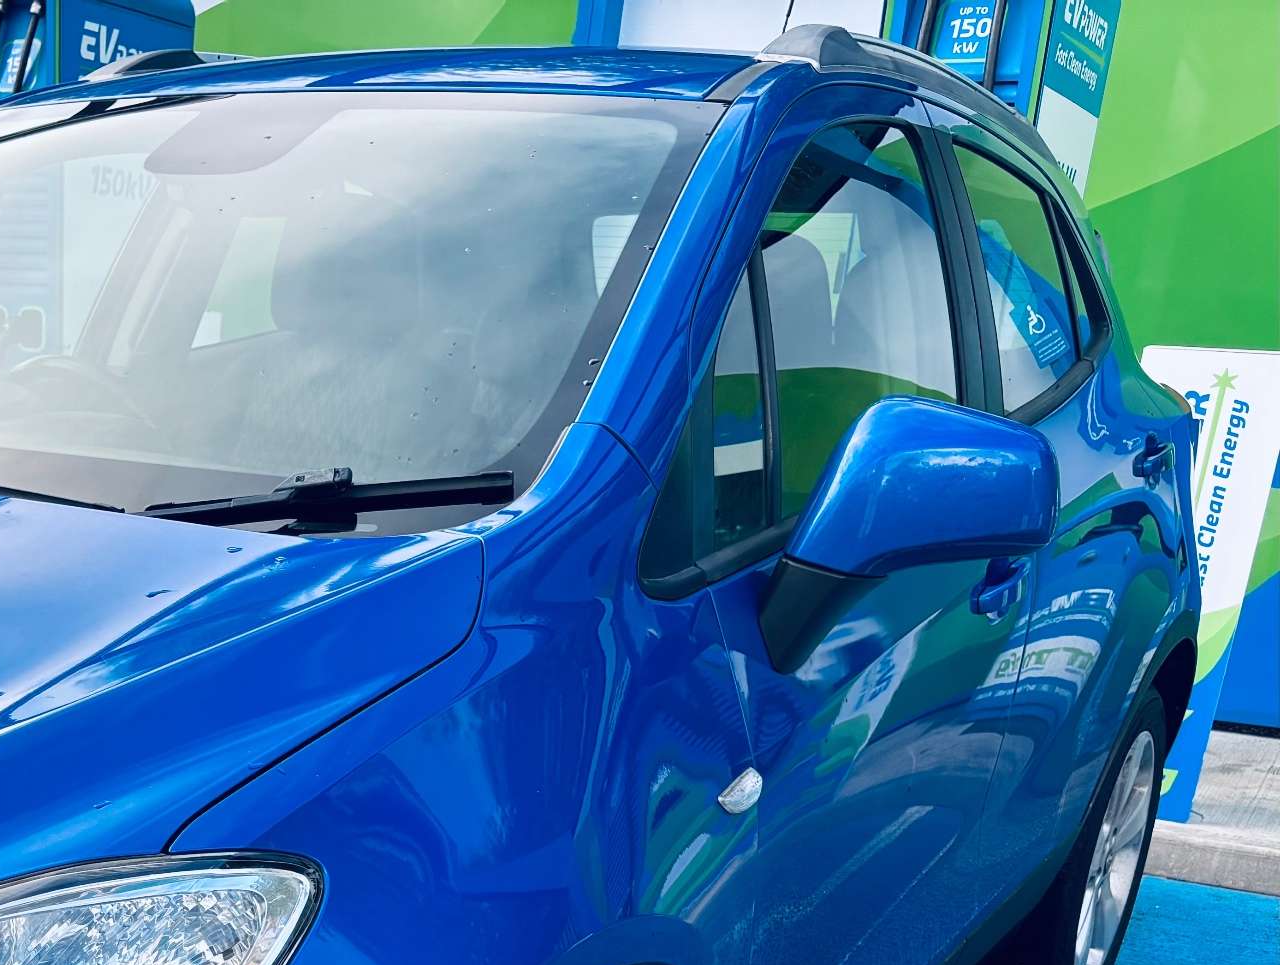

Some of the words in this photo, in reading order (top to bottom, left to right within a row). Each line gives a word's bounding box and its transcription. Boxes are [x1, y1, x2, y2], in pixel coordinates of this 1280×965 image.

[959, 7, 974, 15] UP
[976, 6, 989, 15] TO
[950, 18, 992, 39] 150
[952, 42, 979, 54] kW
[1055, 43, 1068, 64] Fast
[1068, 51, 1083, 78] Clean
[1081, 60, 1098, 91] Energy
[1197, 486, 1227, 548] Clean
[1212, 398, 1250, 479] Energy
